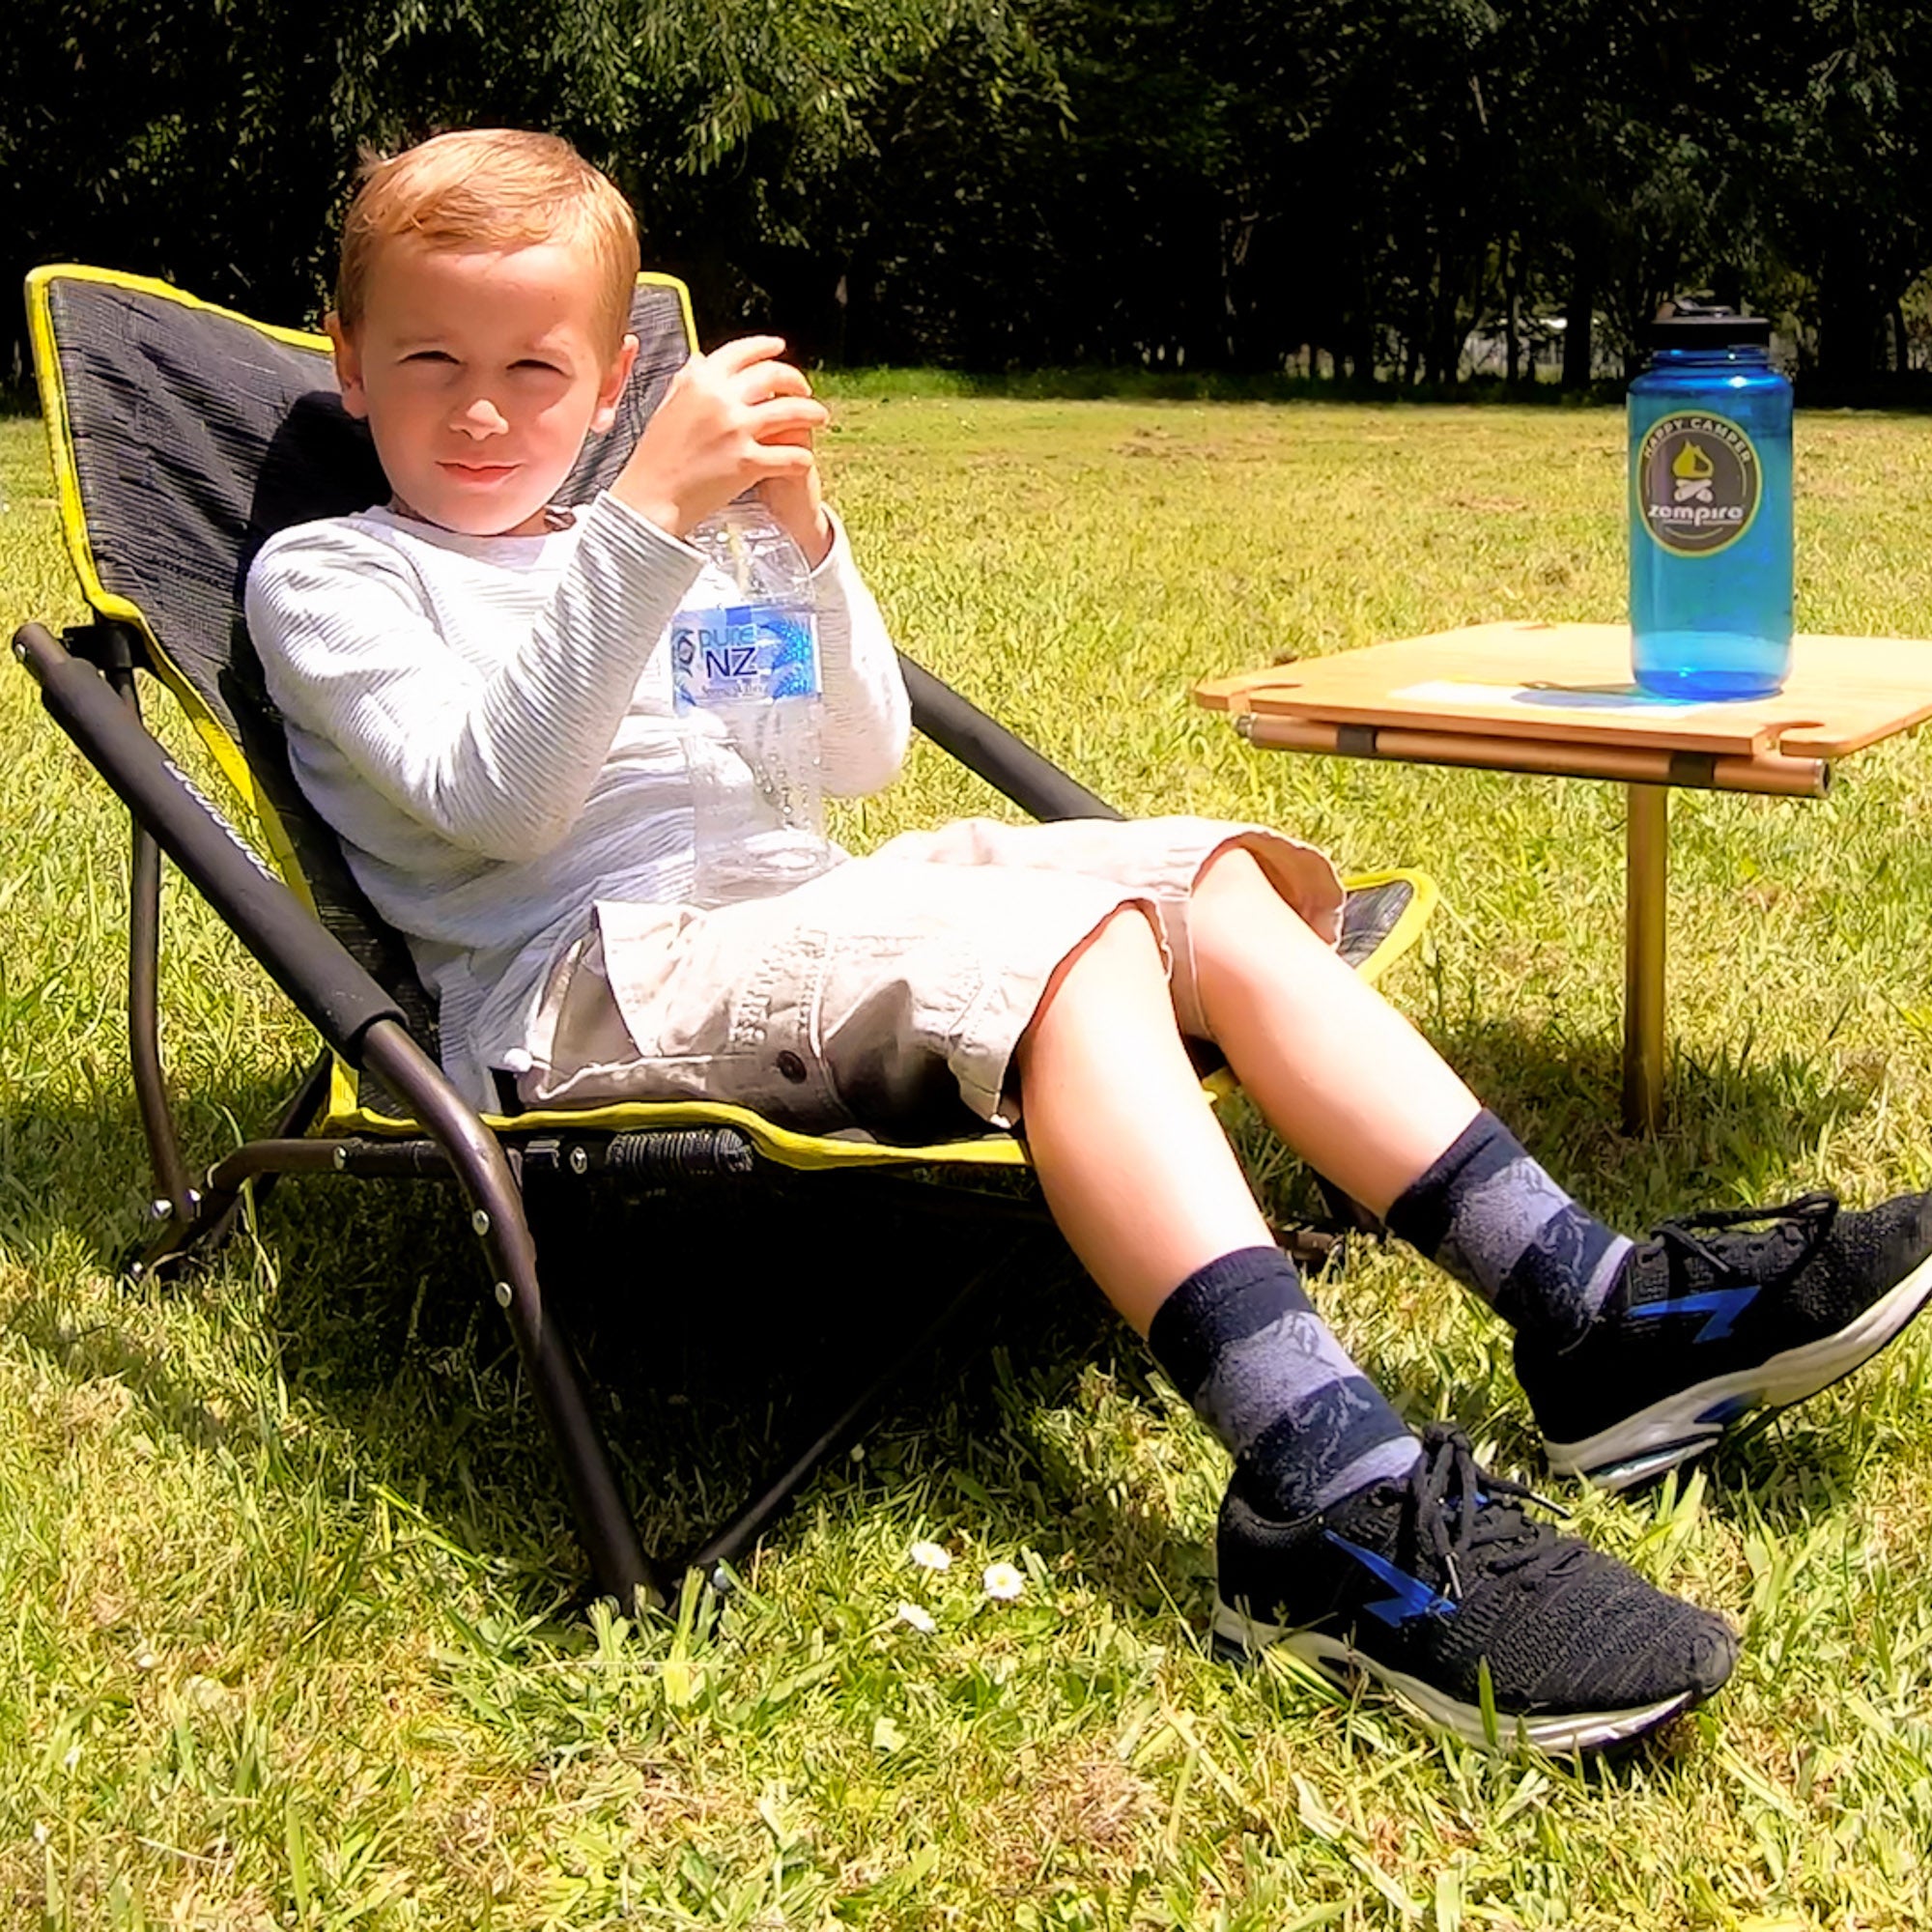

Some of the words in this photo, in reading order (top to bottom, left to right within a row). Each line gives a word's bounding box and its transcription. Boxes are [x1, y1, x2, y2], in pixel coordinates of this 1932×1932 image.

[1643, 418, 1684, 459] HAPPY
[1691, 417, 1751, 463] CAMPER
[697, 627, 754, 659] pure
[706, 647, 757, 678] NZ
